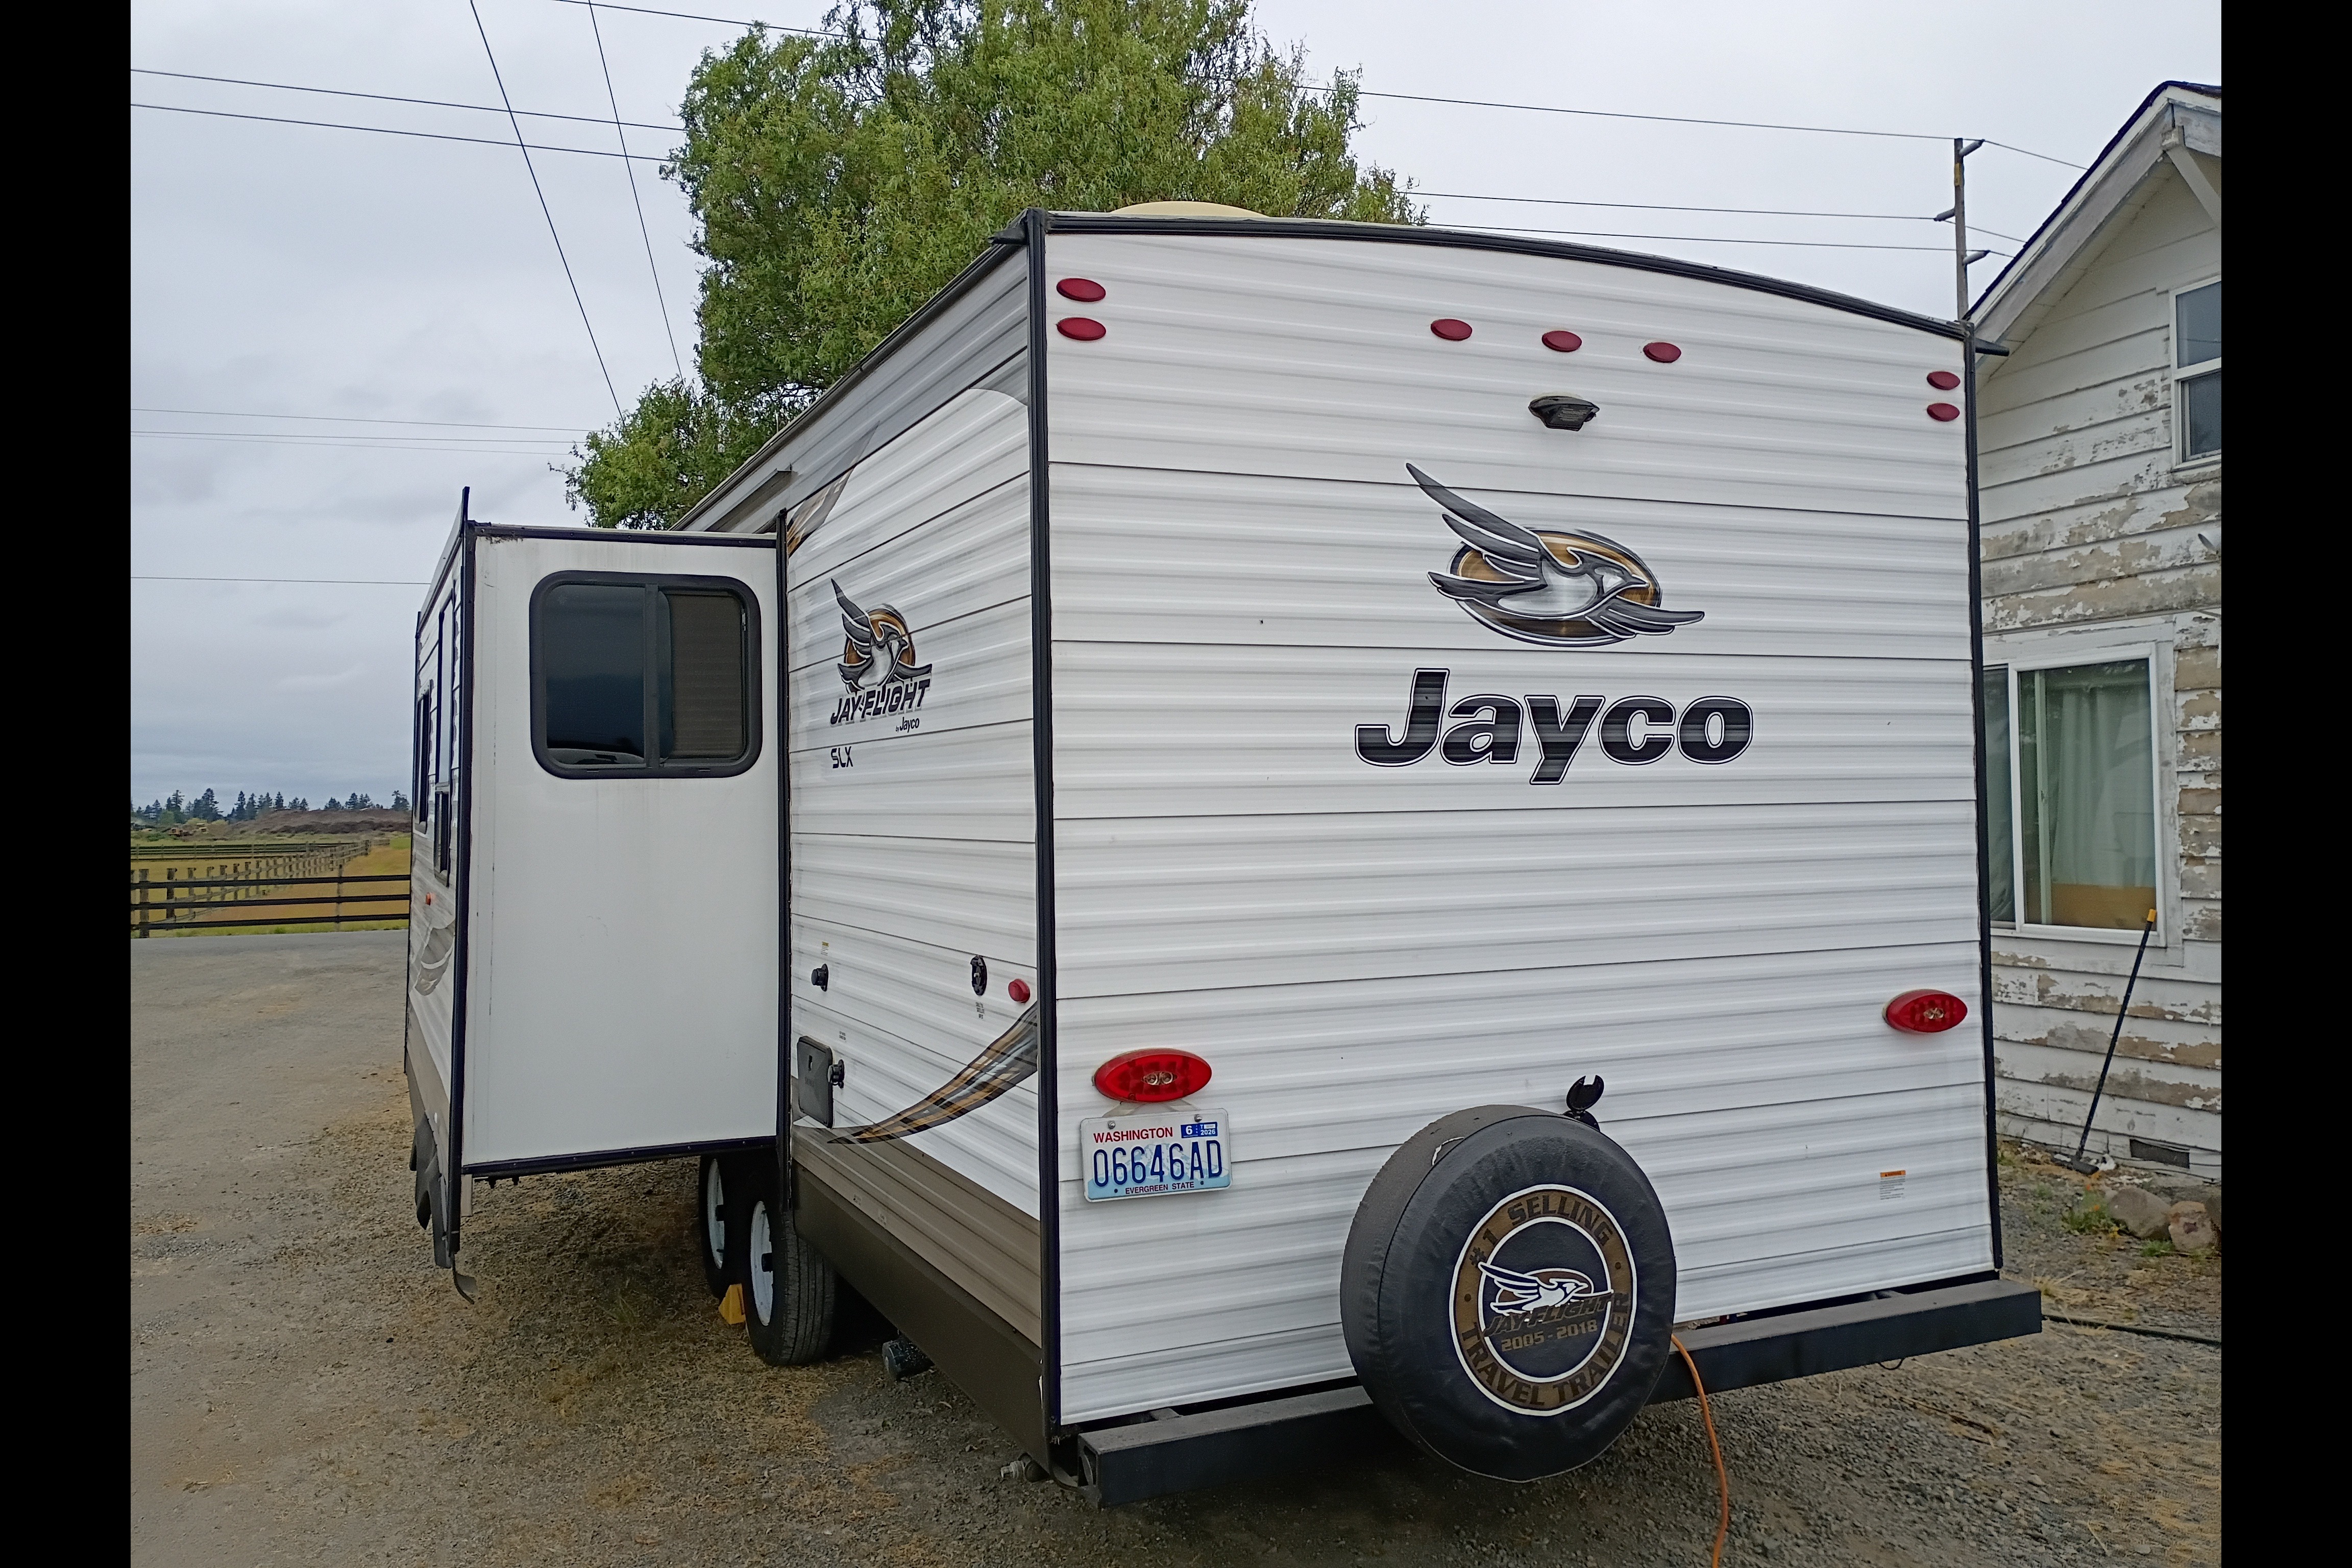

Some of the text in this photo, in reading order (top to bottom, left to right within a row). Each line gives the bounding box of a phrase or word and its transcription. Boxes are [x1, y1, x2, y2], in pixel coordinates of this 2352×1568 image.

[830, 678, 931, 725] JAY FLIGHT
[899, 716, 920, 733] Jayco
[1355, 668, 1753, 785] Jayco
[830, 746, 854, 769] SLX
[1093, 1126, 1173, 1143] WASHINGTON
[1185, 1125, 1193, 1135] 6
[1093, 1140, 1222, 1187] 06646AD
[1125, 1181, 1195, 1194] EVERGREEN STATE
[1507, 1195, 1613, 1247] SELLING
[1461, 1292, 1631, 1406] TRAVEL TRAILER
[1501, 1331, 1545, 1352] 2005
[1556, 1319, 1598, 1339] 2018
